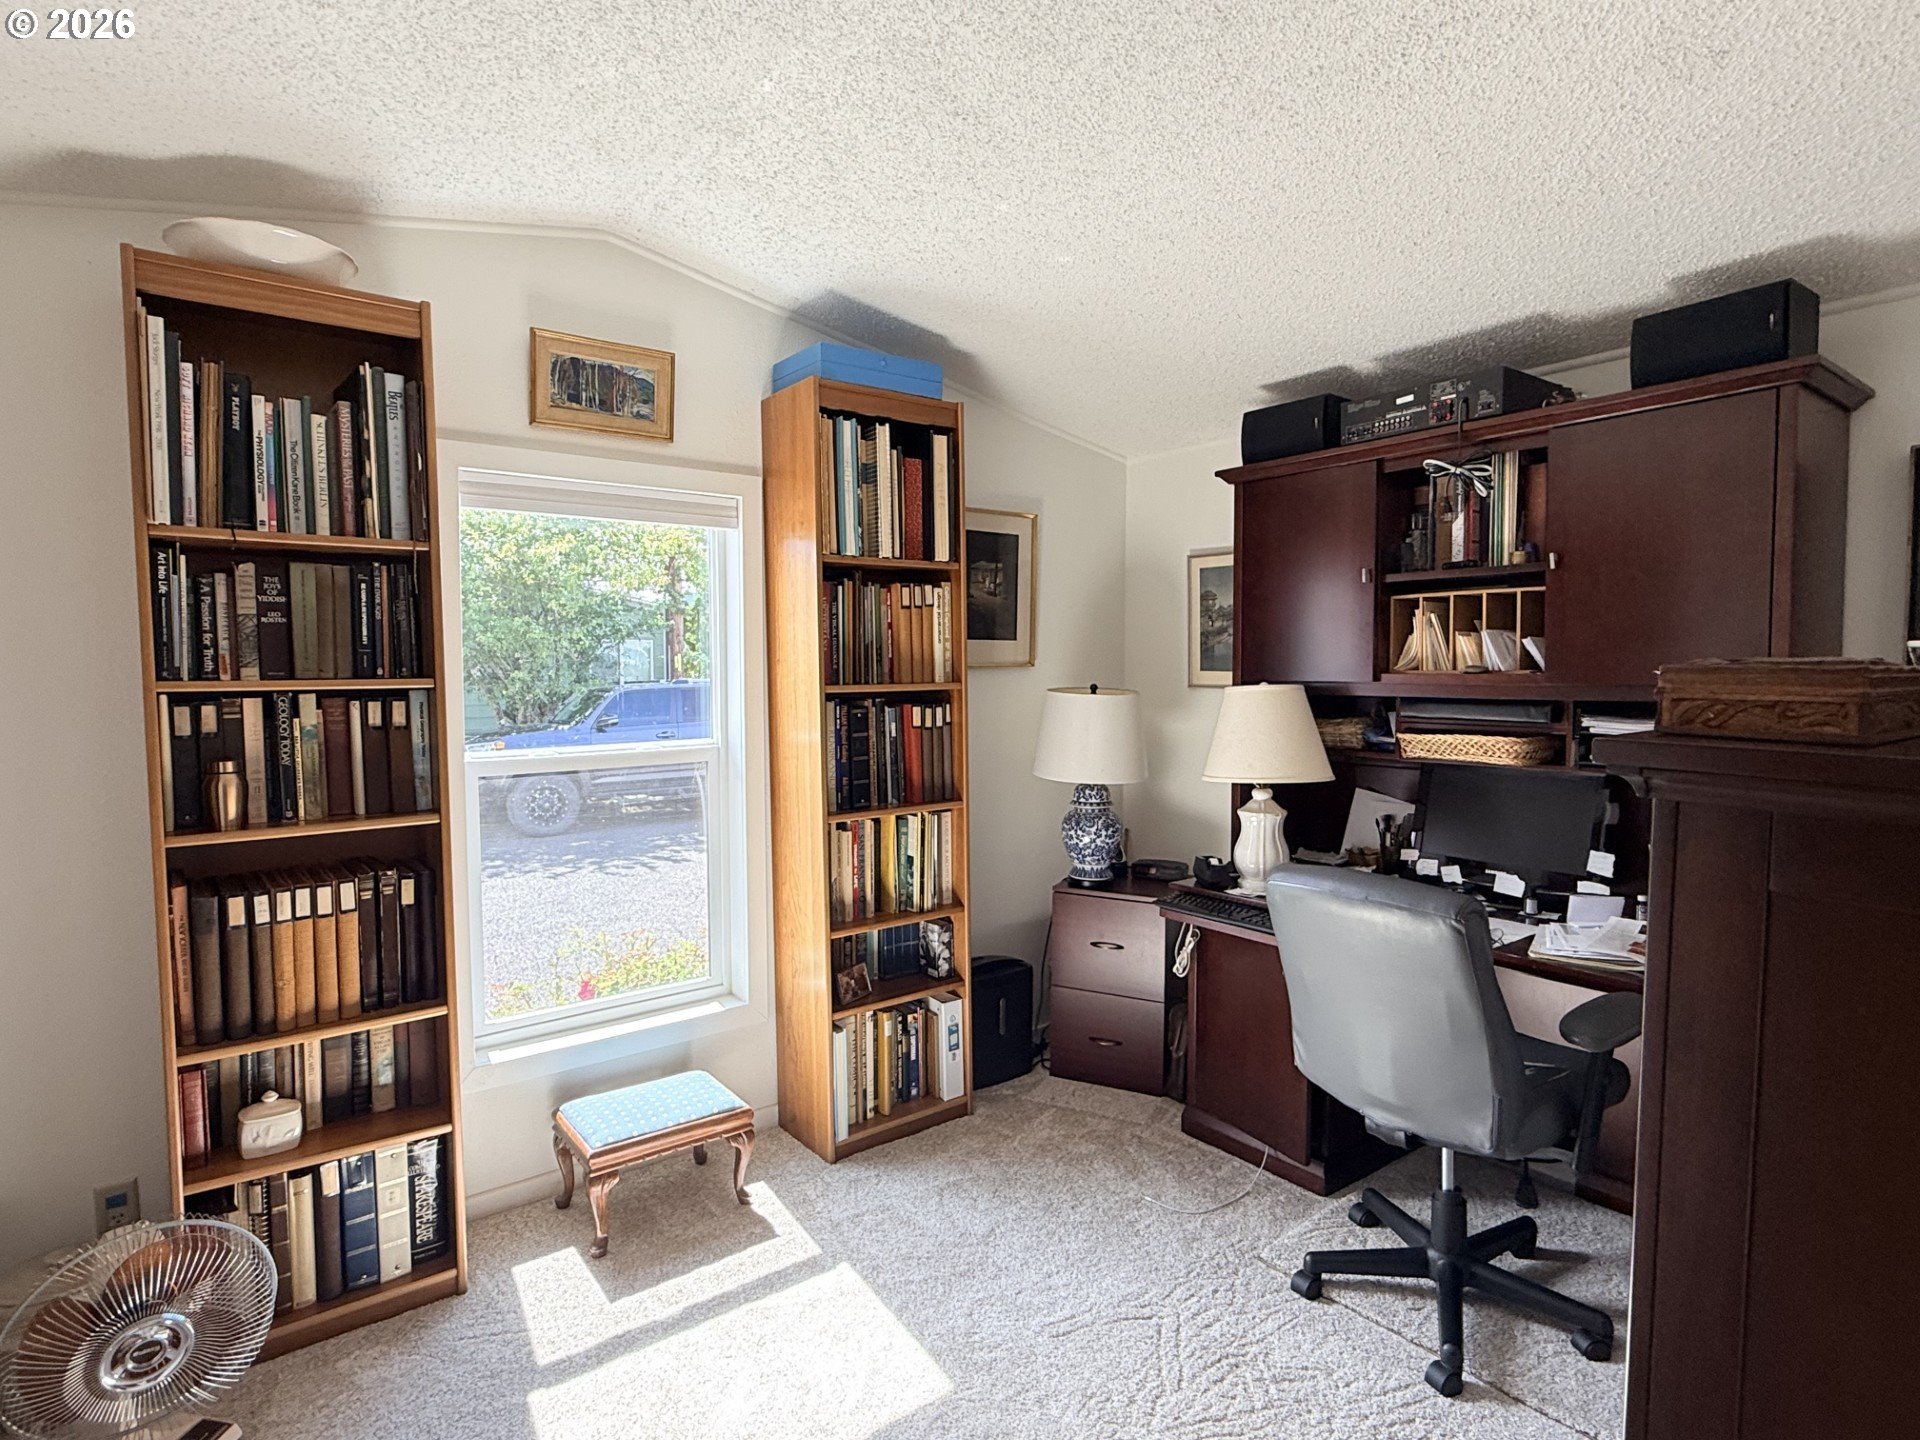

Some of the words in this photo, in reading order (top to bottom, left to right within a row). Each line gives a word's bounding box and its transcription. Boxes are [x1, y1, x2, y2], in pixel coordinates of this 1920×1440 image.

[231, 396, 240, 430] PLAYBOY
[386, 391, 403, 420] BEATLES
[266, 413, 274, 435] MAD
[339, 406, 351, 457] MYSTERIES
[290, 440, 298, 453] The
[256, 436, 264, 485] PHYSIOLOGY
[290, 453, 299, 477] Citizen
[291, 477, 299, 494] Kane
[343, 468, 353, 489] PAST
[318, 475, 327, 508] BERLIN
[293, 495, 301, 513] Book
[157, 552, 166, 563] Art
[158, 565, 167, 579] Into
[158, 581, 167, 594] Life
[200, 584, 210, 593] A
[263, 582, 281, 590] JOYS
[200, 596, 212, 630] Passion
[202, 633, 213, 646] for
[203, 647, 214, 672] Truth
[278, 697, 289, 737] GEOLOGY
[280, 739, 291, 766] TODAY
[858, 854, 866, 903] FRANCISCO
[414, 1174, 437, 1244] SHAKESPEARE
